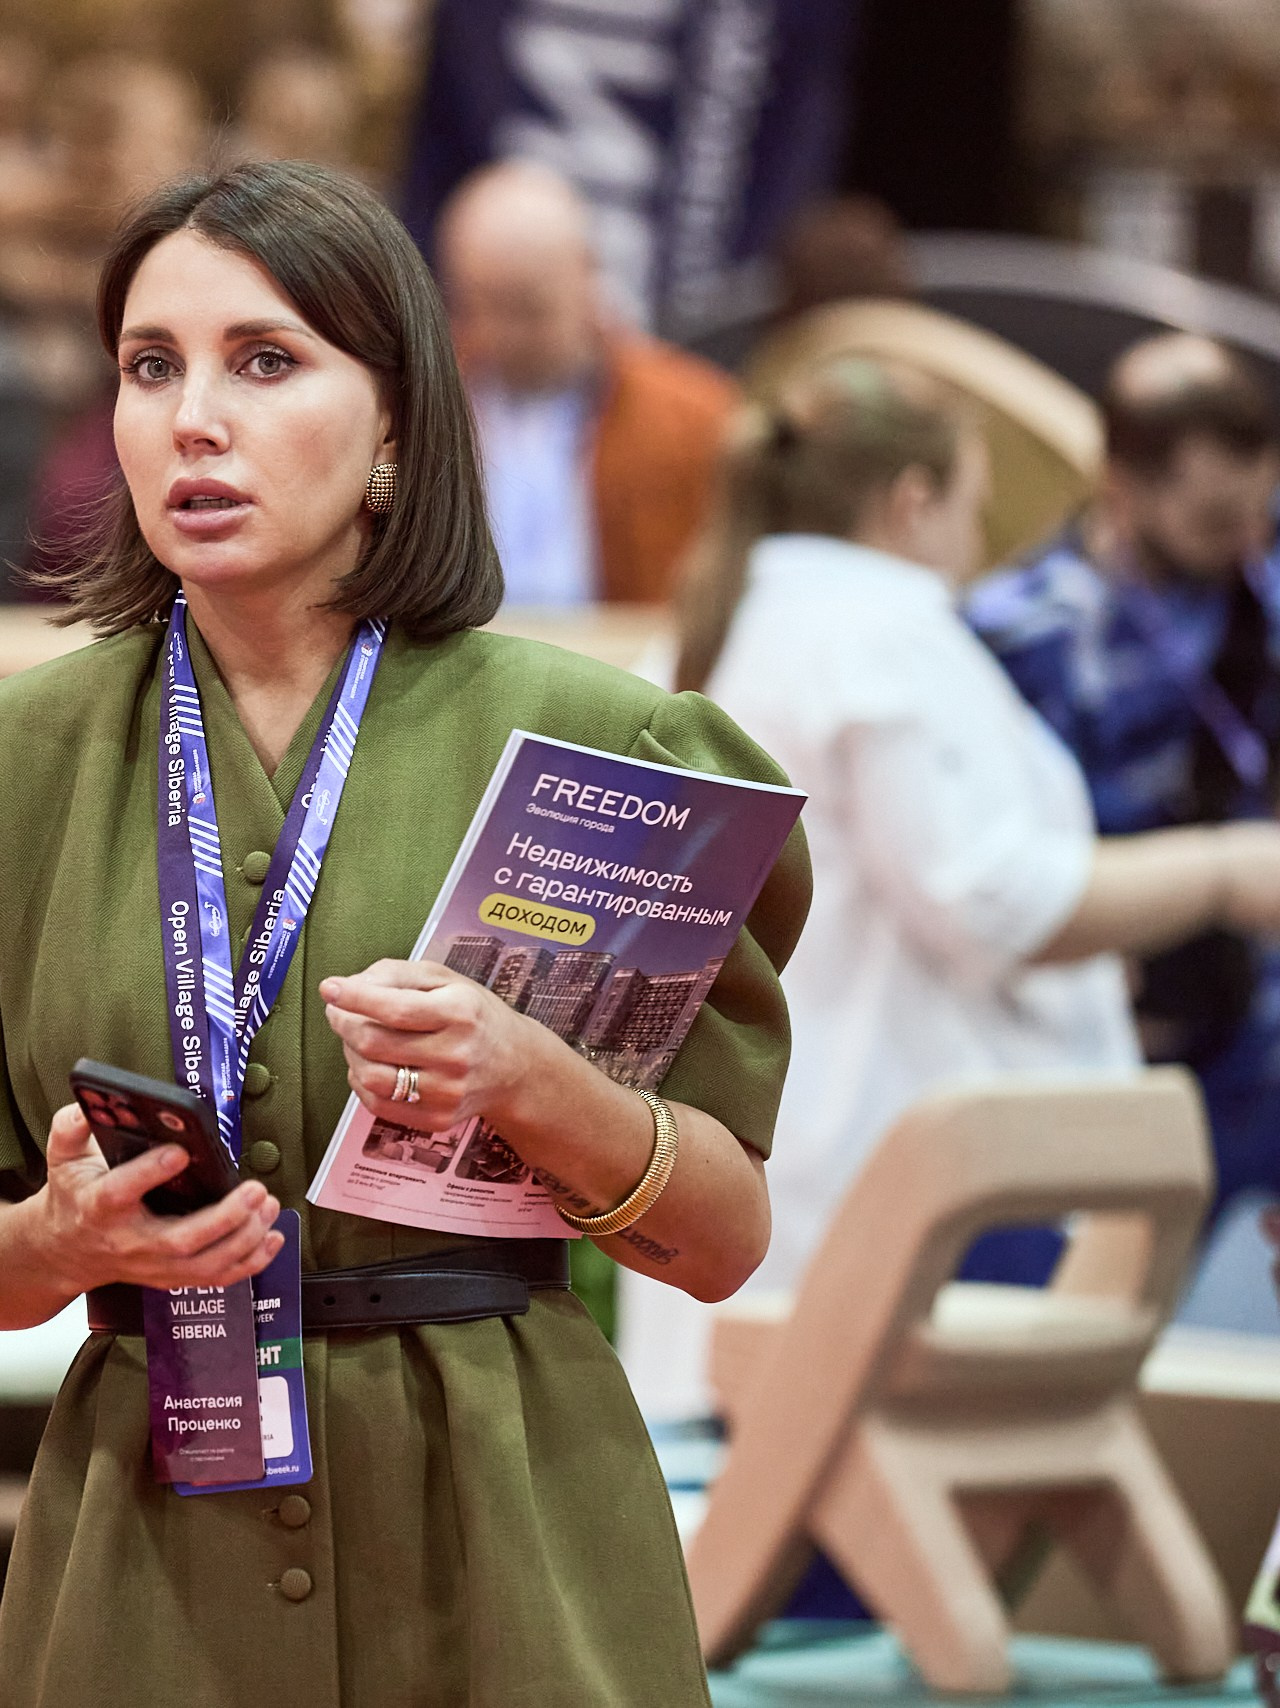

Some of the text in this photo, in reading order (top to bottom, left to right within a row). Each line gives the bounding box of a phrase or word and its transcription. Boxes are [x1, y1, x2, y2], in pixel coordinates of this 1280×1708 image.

[168, 758, 186, 827] Siberia
[526, 802, 615, 833] Эволюция города
[531, 773, 691, 831] FREEDOM
[506, 832, 693, 893] Недвижимость
[494, 867, 733, 927] с гарантированным
[167, 901, 190, 956] Open
[249, 888, 286, 965] Siberia
[175, 959, 196, 1031] Village
[170, 1299, 226, 1316] VILLAGE
[172, 1324, 227, 1340] SIBERIA
[164, 1395, 243, 1410] Анастасия
[167, 1417, 241, 1435] Проценко
